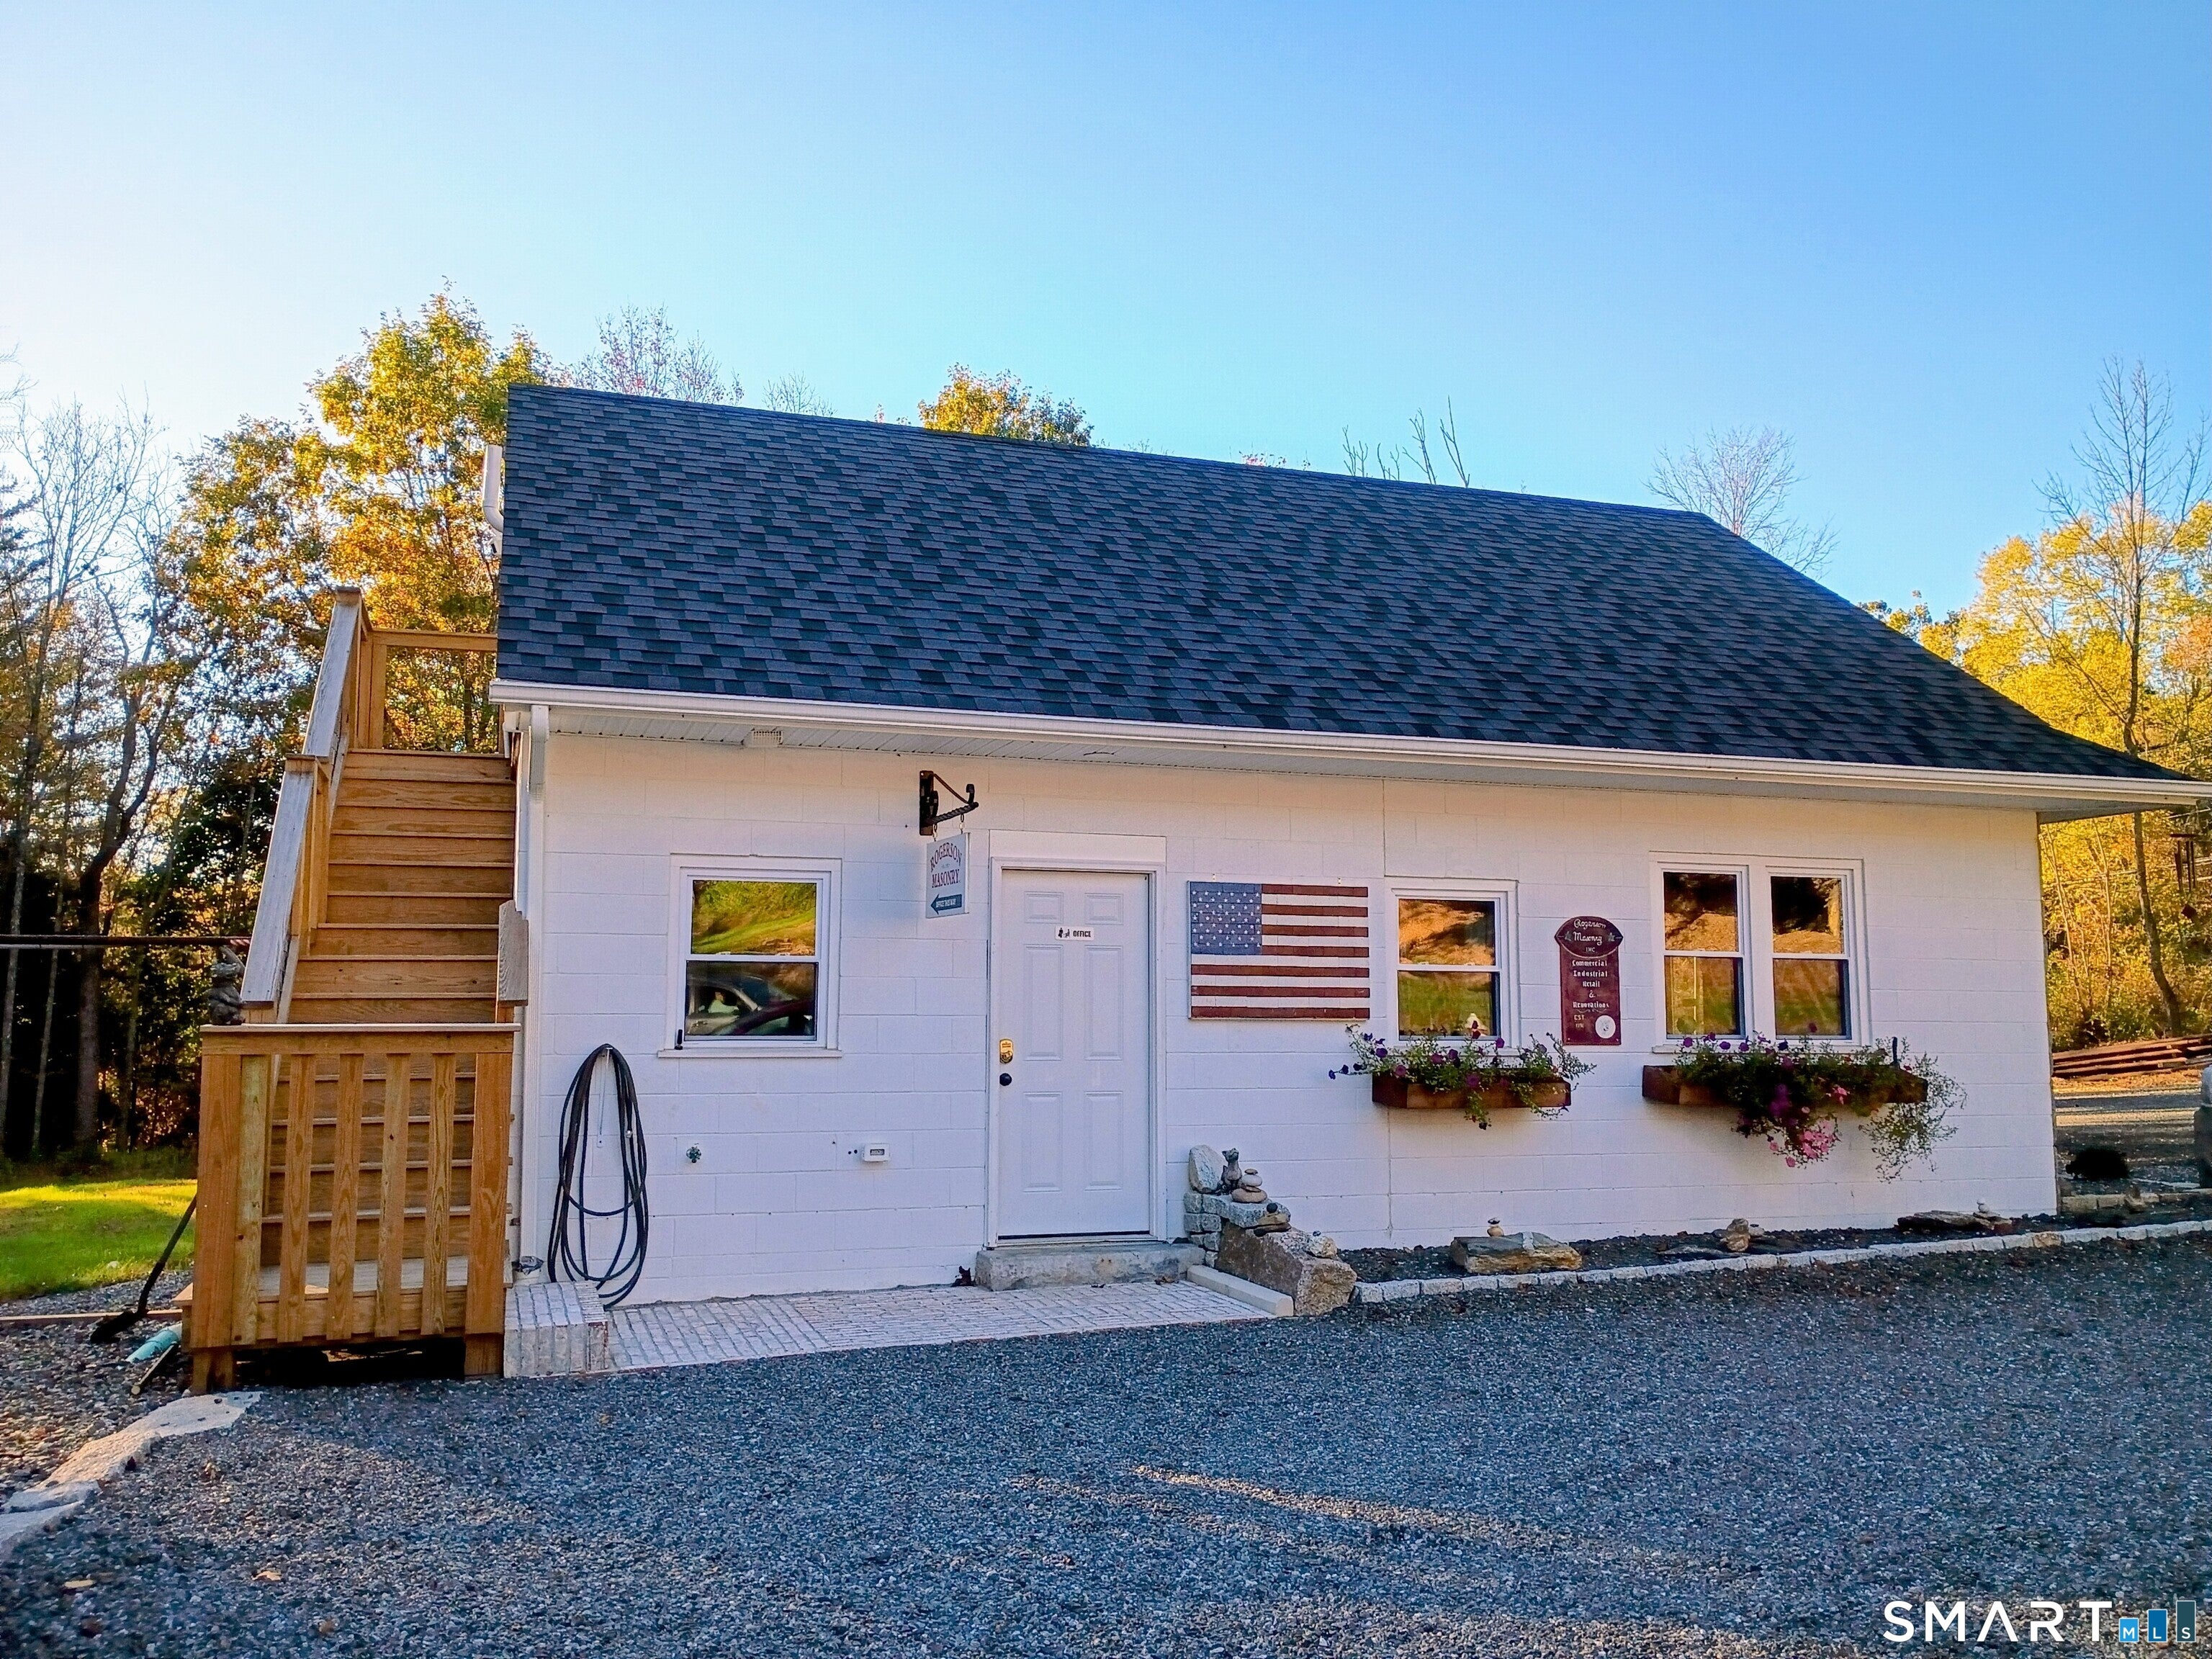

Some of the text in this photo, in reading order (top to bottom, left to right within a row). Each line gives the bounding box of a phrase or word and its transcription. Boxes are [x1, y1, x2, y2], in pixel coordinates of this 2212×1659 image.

[930, 842, 962, 873] ROGERSON
[1573, 919, 1606, 930] Rogerson
[1573, 931, 1603, 946] Masonry
